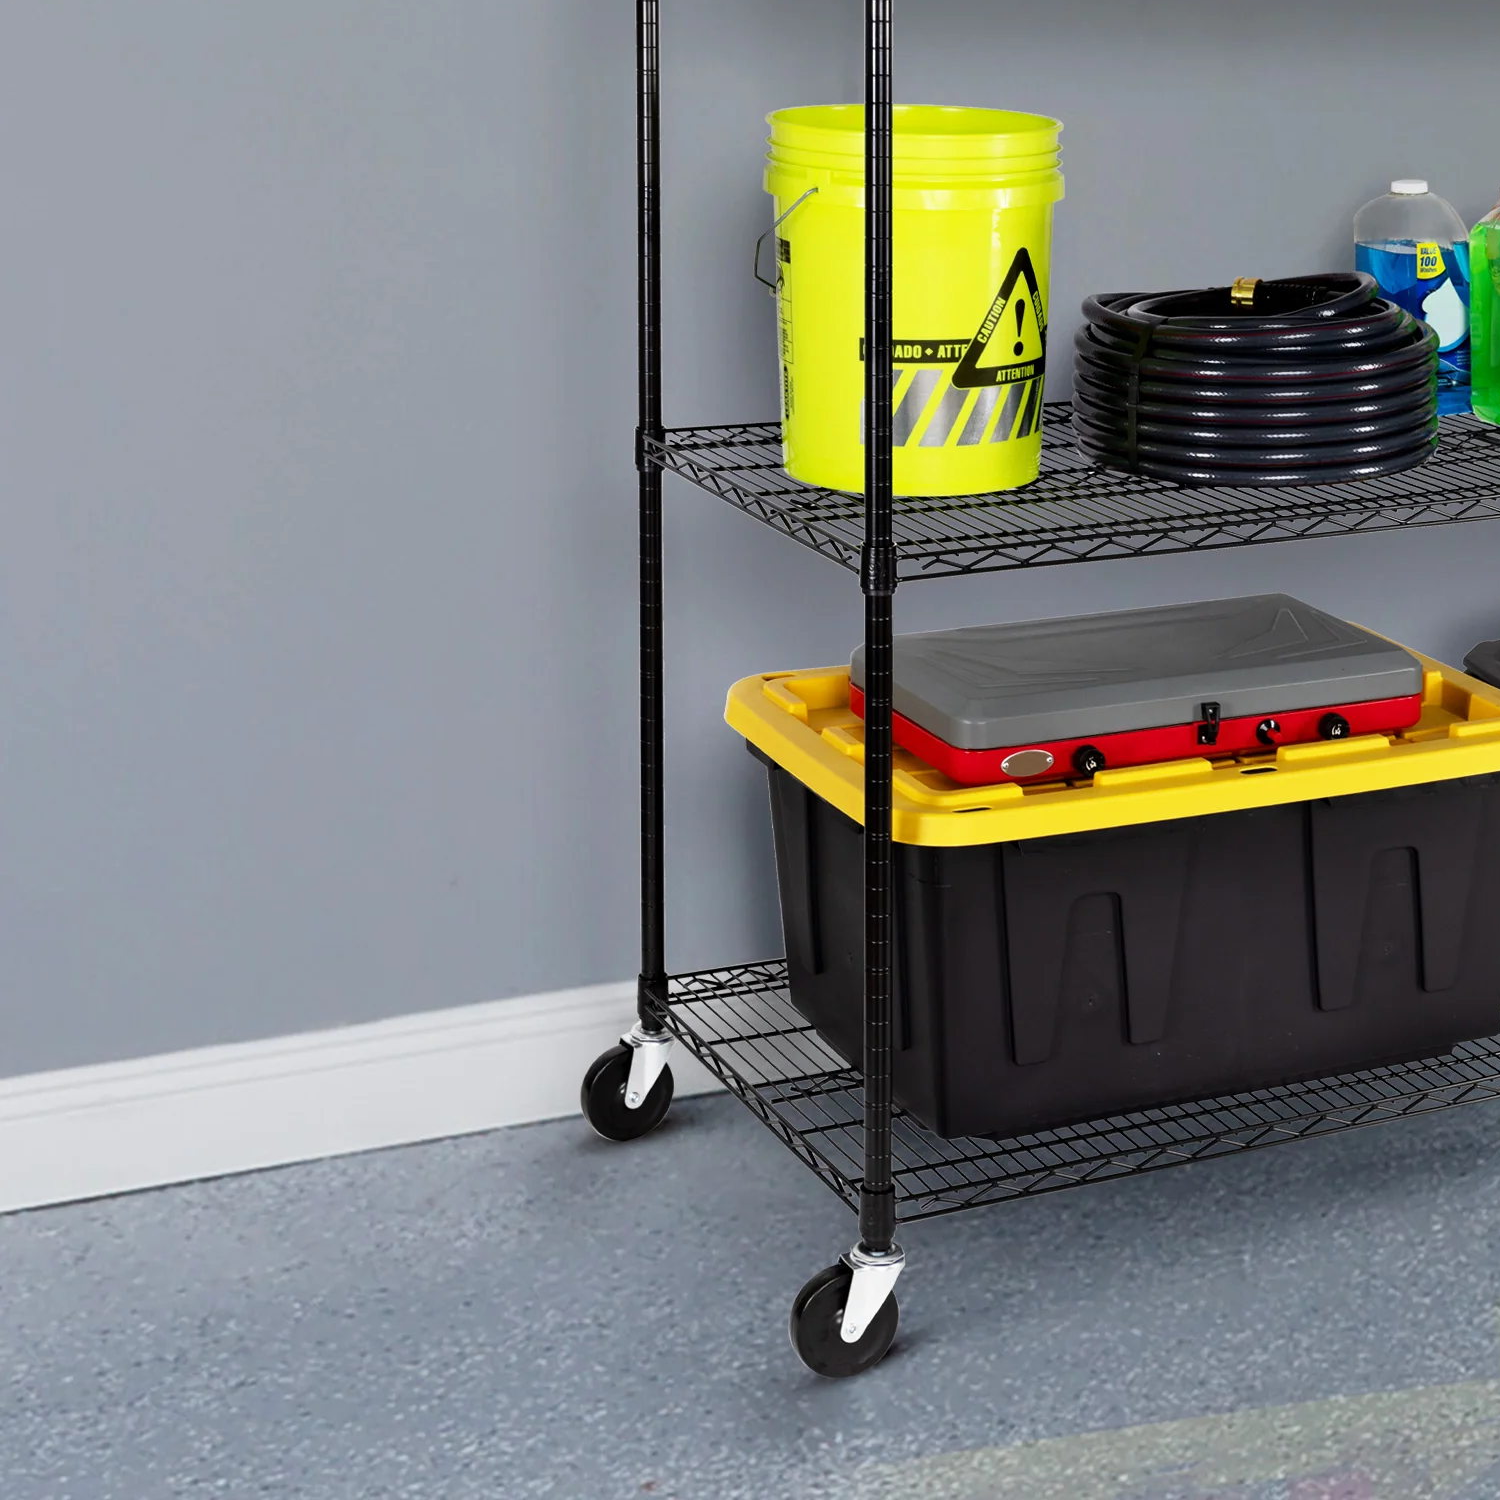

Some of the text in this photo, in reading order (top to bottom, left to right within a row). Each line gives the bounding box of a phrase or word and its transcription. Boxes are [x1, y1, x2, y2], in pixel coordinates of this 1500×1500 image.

[1420, 256, 1437, 267] 100
[976, 296, 1006, 344] CAUTION
[995, 364, 1035, 382] ATTENTION
